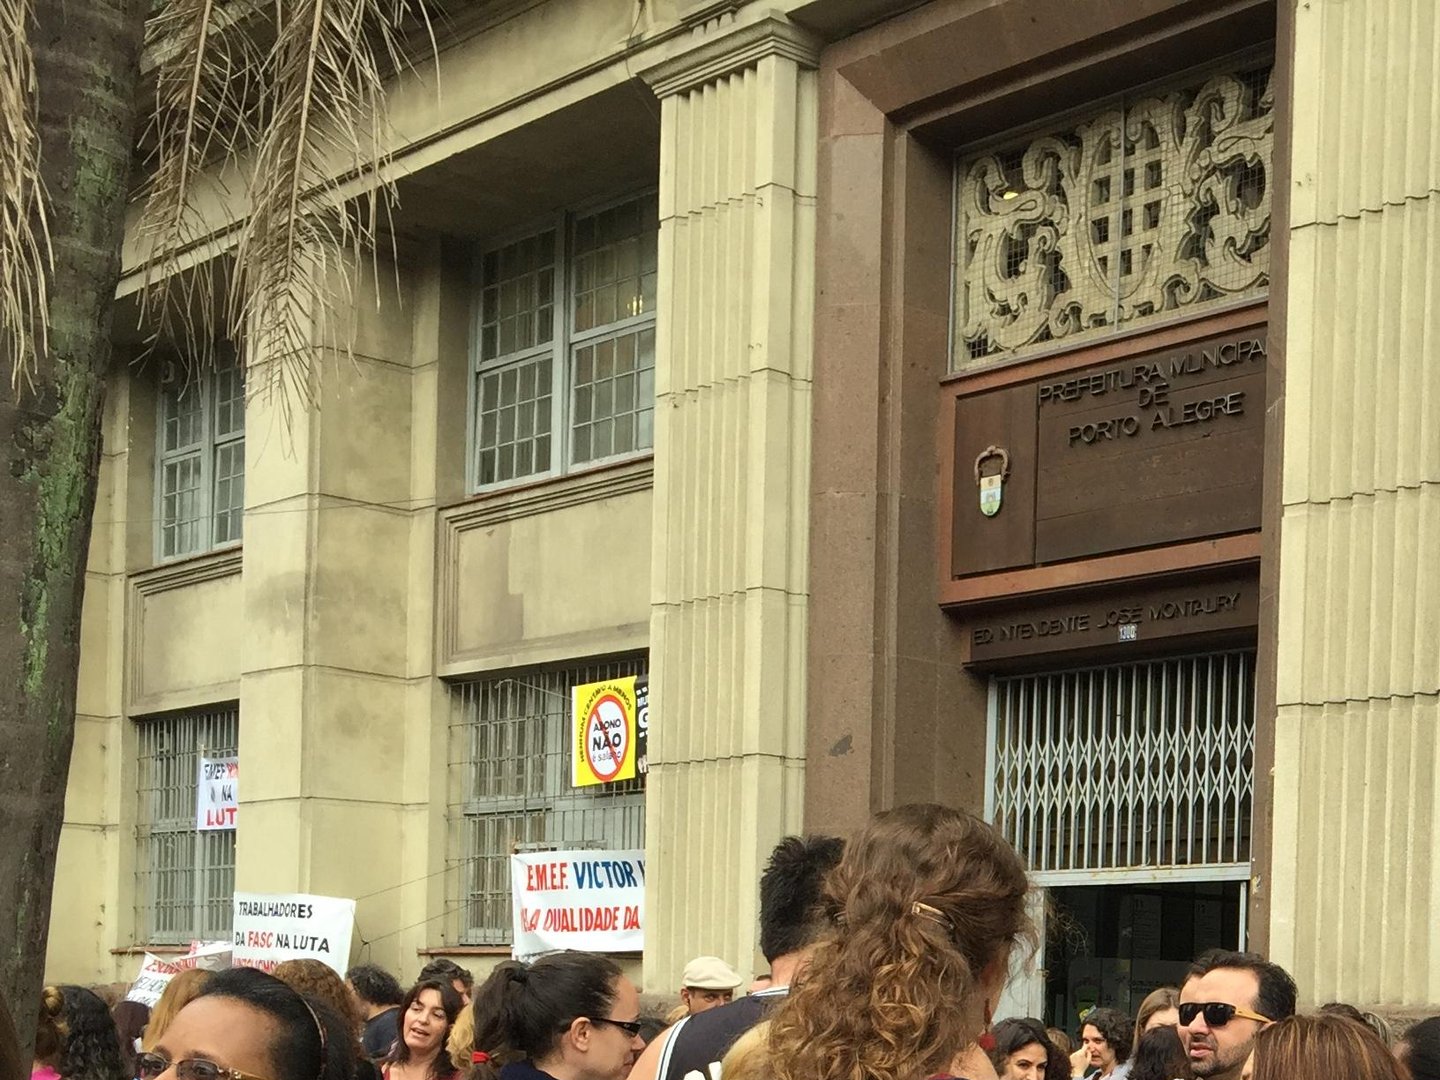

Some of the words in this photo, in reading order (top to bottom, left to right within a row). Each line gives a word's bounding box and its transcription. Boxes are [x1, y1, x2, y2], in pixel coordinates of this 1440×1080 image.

[1039, 362, 1168, 405] PREFEITURA
[1170, 339, 1267, 378] MUNICIPA
[1138, 382, 1170, 408] DE
[1068, 415, 1140, 448] PORTO
[1151, 391, 1245, 432] ALEGRE
[593, 730, 622, 751] NÃO
[207, 807, 237, 826] LUT
[573, 860, 638, 889] VICTOR
[239, 902, 313, 918] TRABALHADORES
[623, 905, 641, 930] DA
[235, 932, 245, 946] DA
[248, 931, 273, 948] FASC
[275, 933, 290, 949] NA
[293, 935, 330, 953] LUTA
